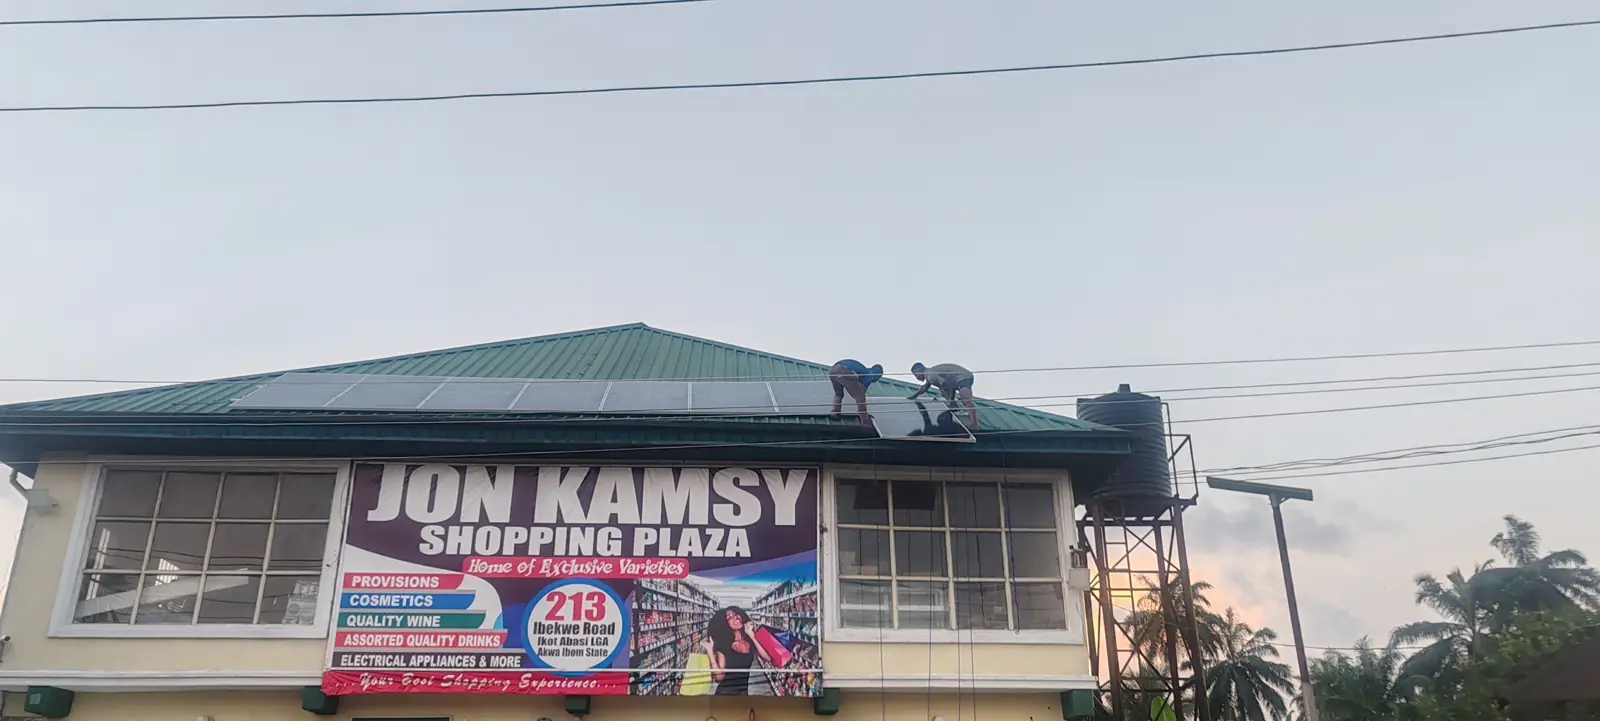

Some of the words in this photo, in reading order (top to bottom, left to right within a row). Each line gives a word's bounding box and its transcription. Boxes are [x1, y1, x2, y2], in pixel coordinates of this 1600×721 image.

[367, 463, 514, 523] JON
[534, 465, 808, 526] KAMSY
[419, 525, 622, 557] SHOPPING
[633, 527, 751, 557] PLAZA
[467, 558, 512, 574] Home
[517, 559, 536, 576] of
[539, 558, 613, 577] Exclusive
[619, 559, 685, 576] Varieties
[351, 575, 440, 588] PROVISIONS
[349, 595, 433, 607] COSMETICS
[545, 591, 607, 622] 213
[346, 615, 403, 627] QUALITY
[407, 616, 441, 627] WINE
[533, 622, 580, 635] Ibekwe
[583, 622, 616, 635] Road
[344, 634, 404, 646] ASSORTED
[407, 634, 456, 647] QUALITY
[458, 635, 500, 647] DRINKS
[537, 636, 558, 646] Ikot
[559, 636, 588, 646] Abasi
[590, 637, 609, 646] LGA
[537, 648, 560, 657] Akwa
[562, 648, 584, 657] Ibom
[585, 648, 608, 657] State
[340, 654, 406, 667] ELECTRICAL
[409, 655, 476, 667] APPLIANCES
[478, 656, 487, 667] &
[489, 656, 521, 668] MORE
[440, 674, 512, 691] Shopping
